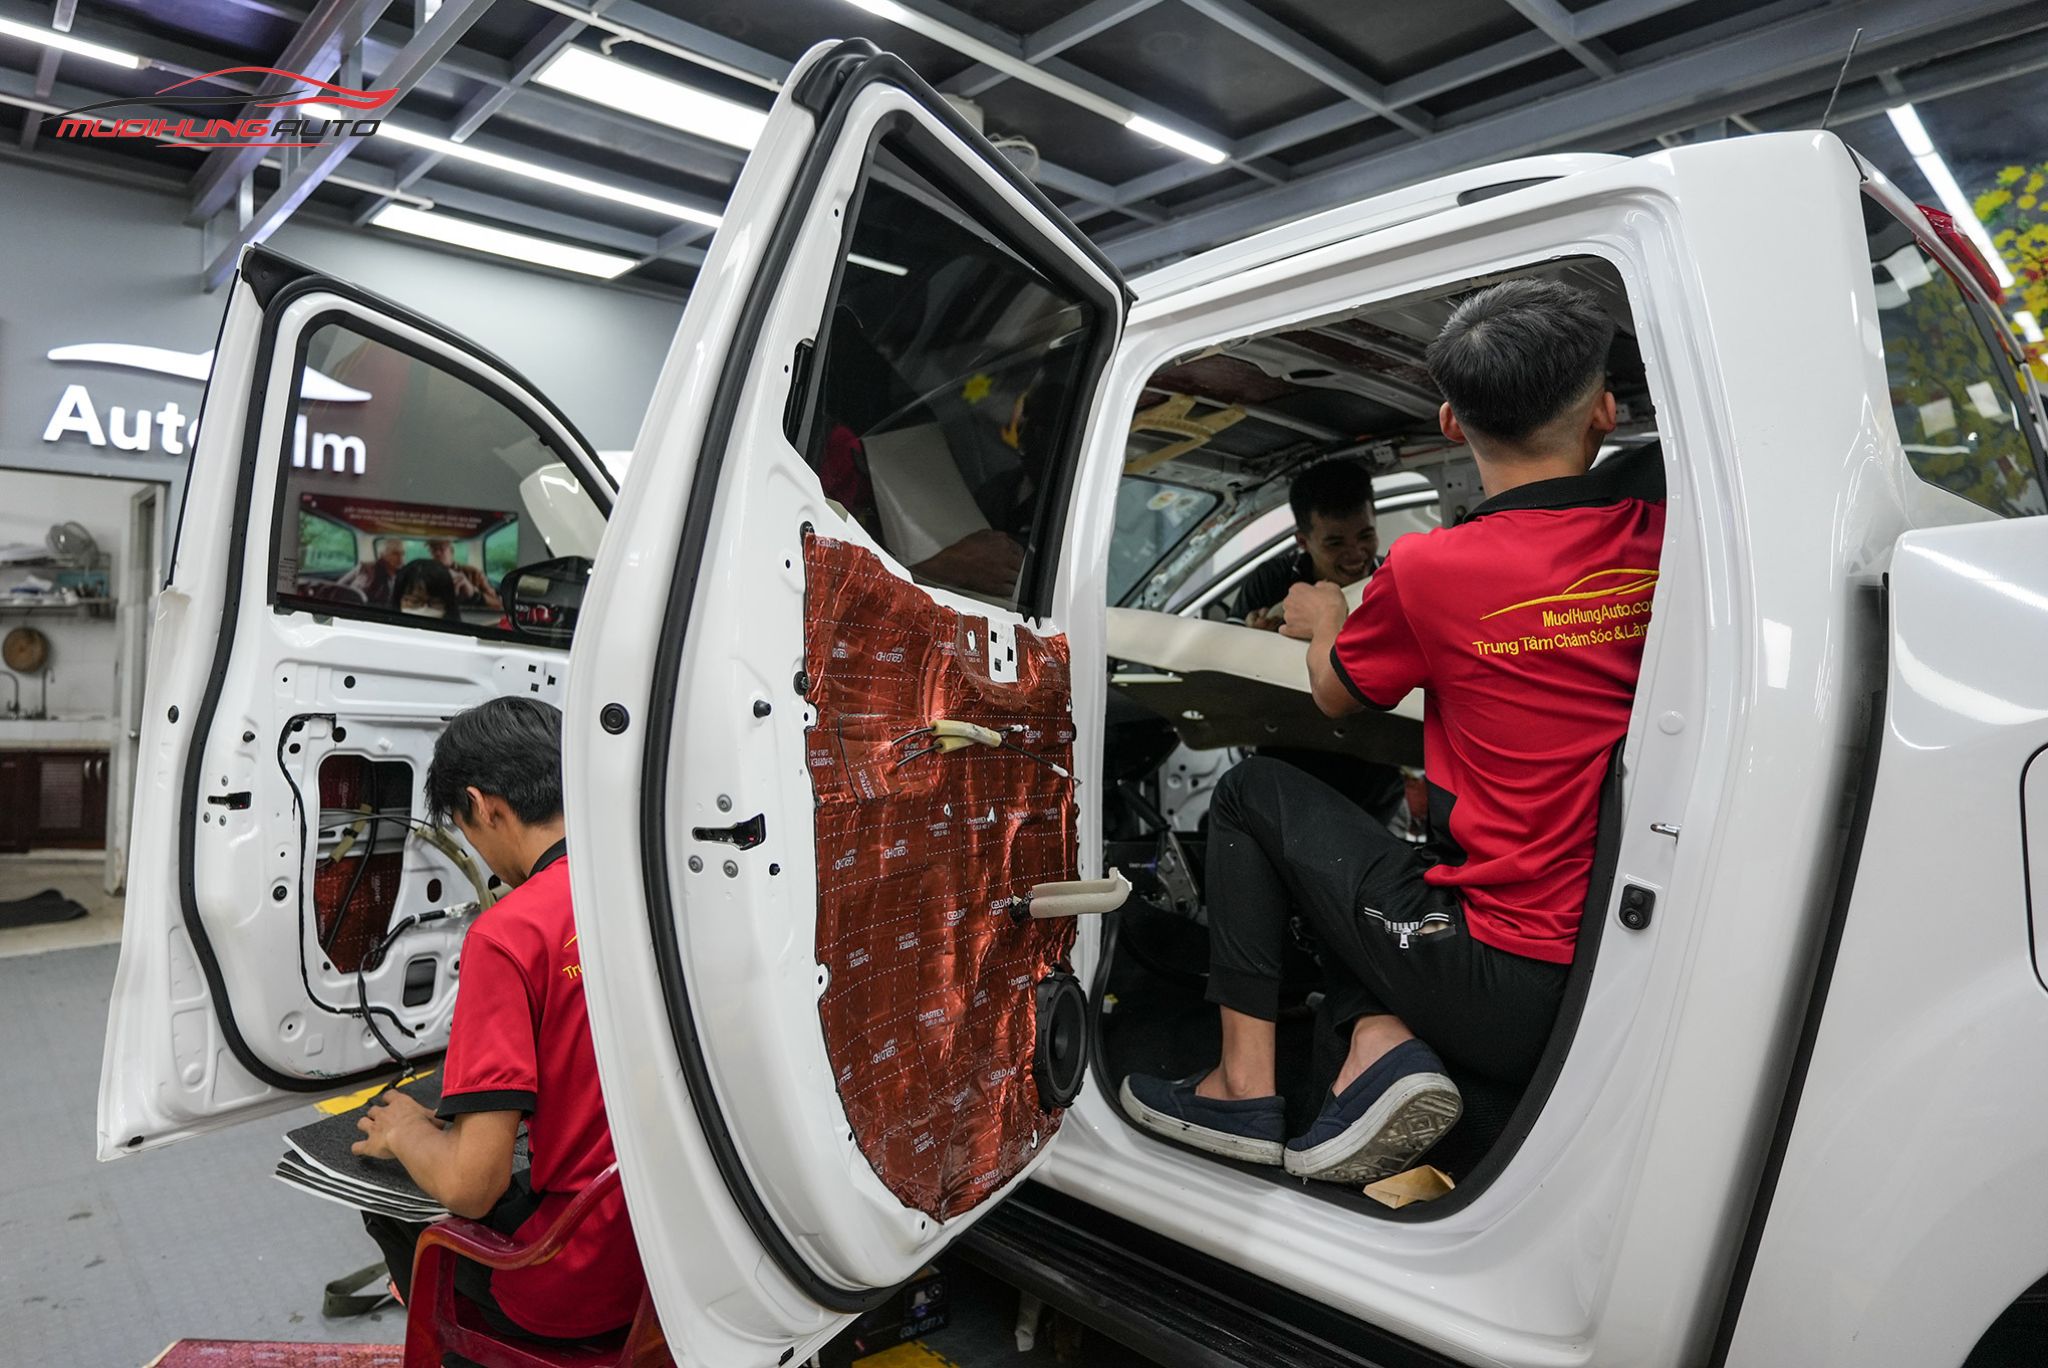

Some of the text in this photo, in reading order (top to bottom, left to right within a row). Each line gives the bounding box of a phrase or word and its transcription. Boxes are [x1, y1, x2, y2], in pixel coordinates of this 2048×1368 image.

[43, 384, 367, 476] Aut lm
[1543, 600, 1653, 628] MuoiHungAuto.co
[1472, 640, 1519, 656] Trung
[1519, 635, 1554, 652] Tâm
[1554, 630, 1590, 649] Chăm
[1590, 626, 1613, 645] Sóc
[1613, 625, 1626, 642] &
